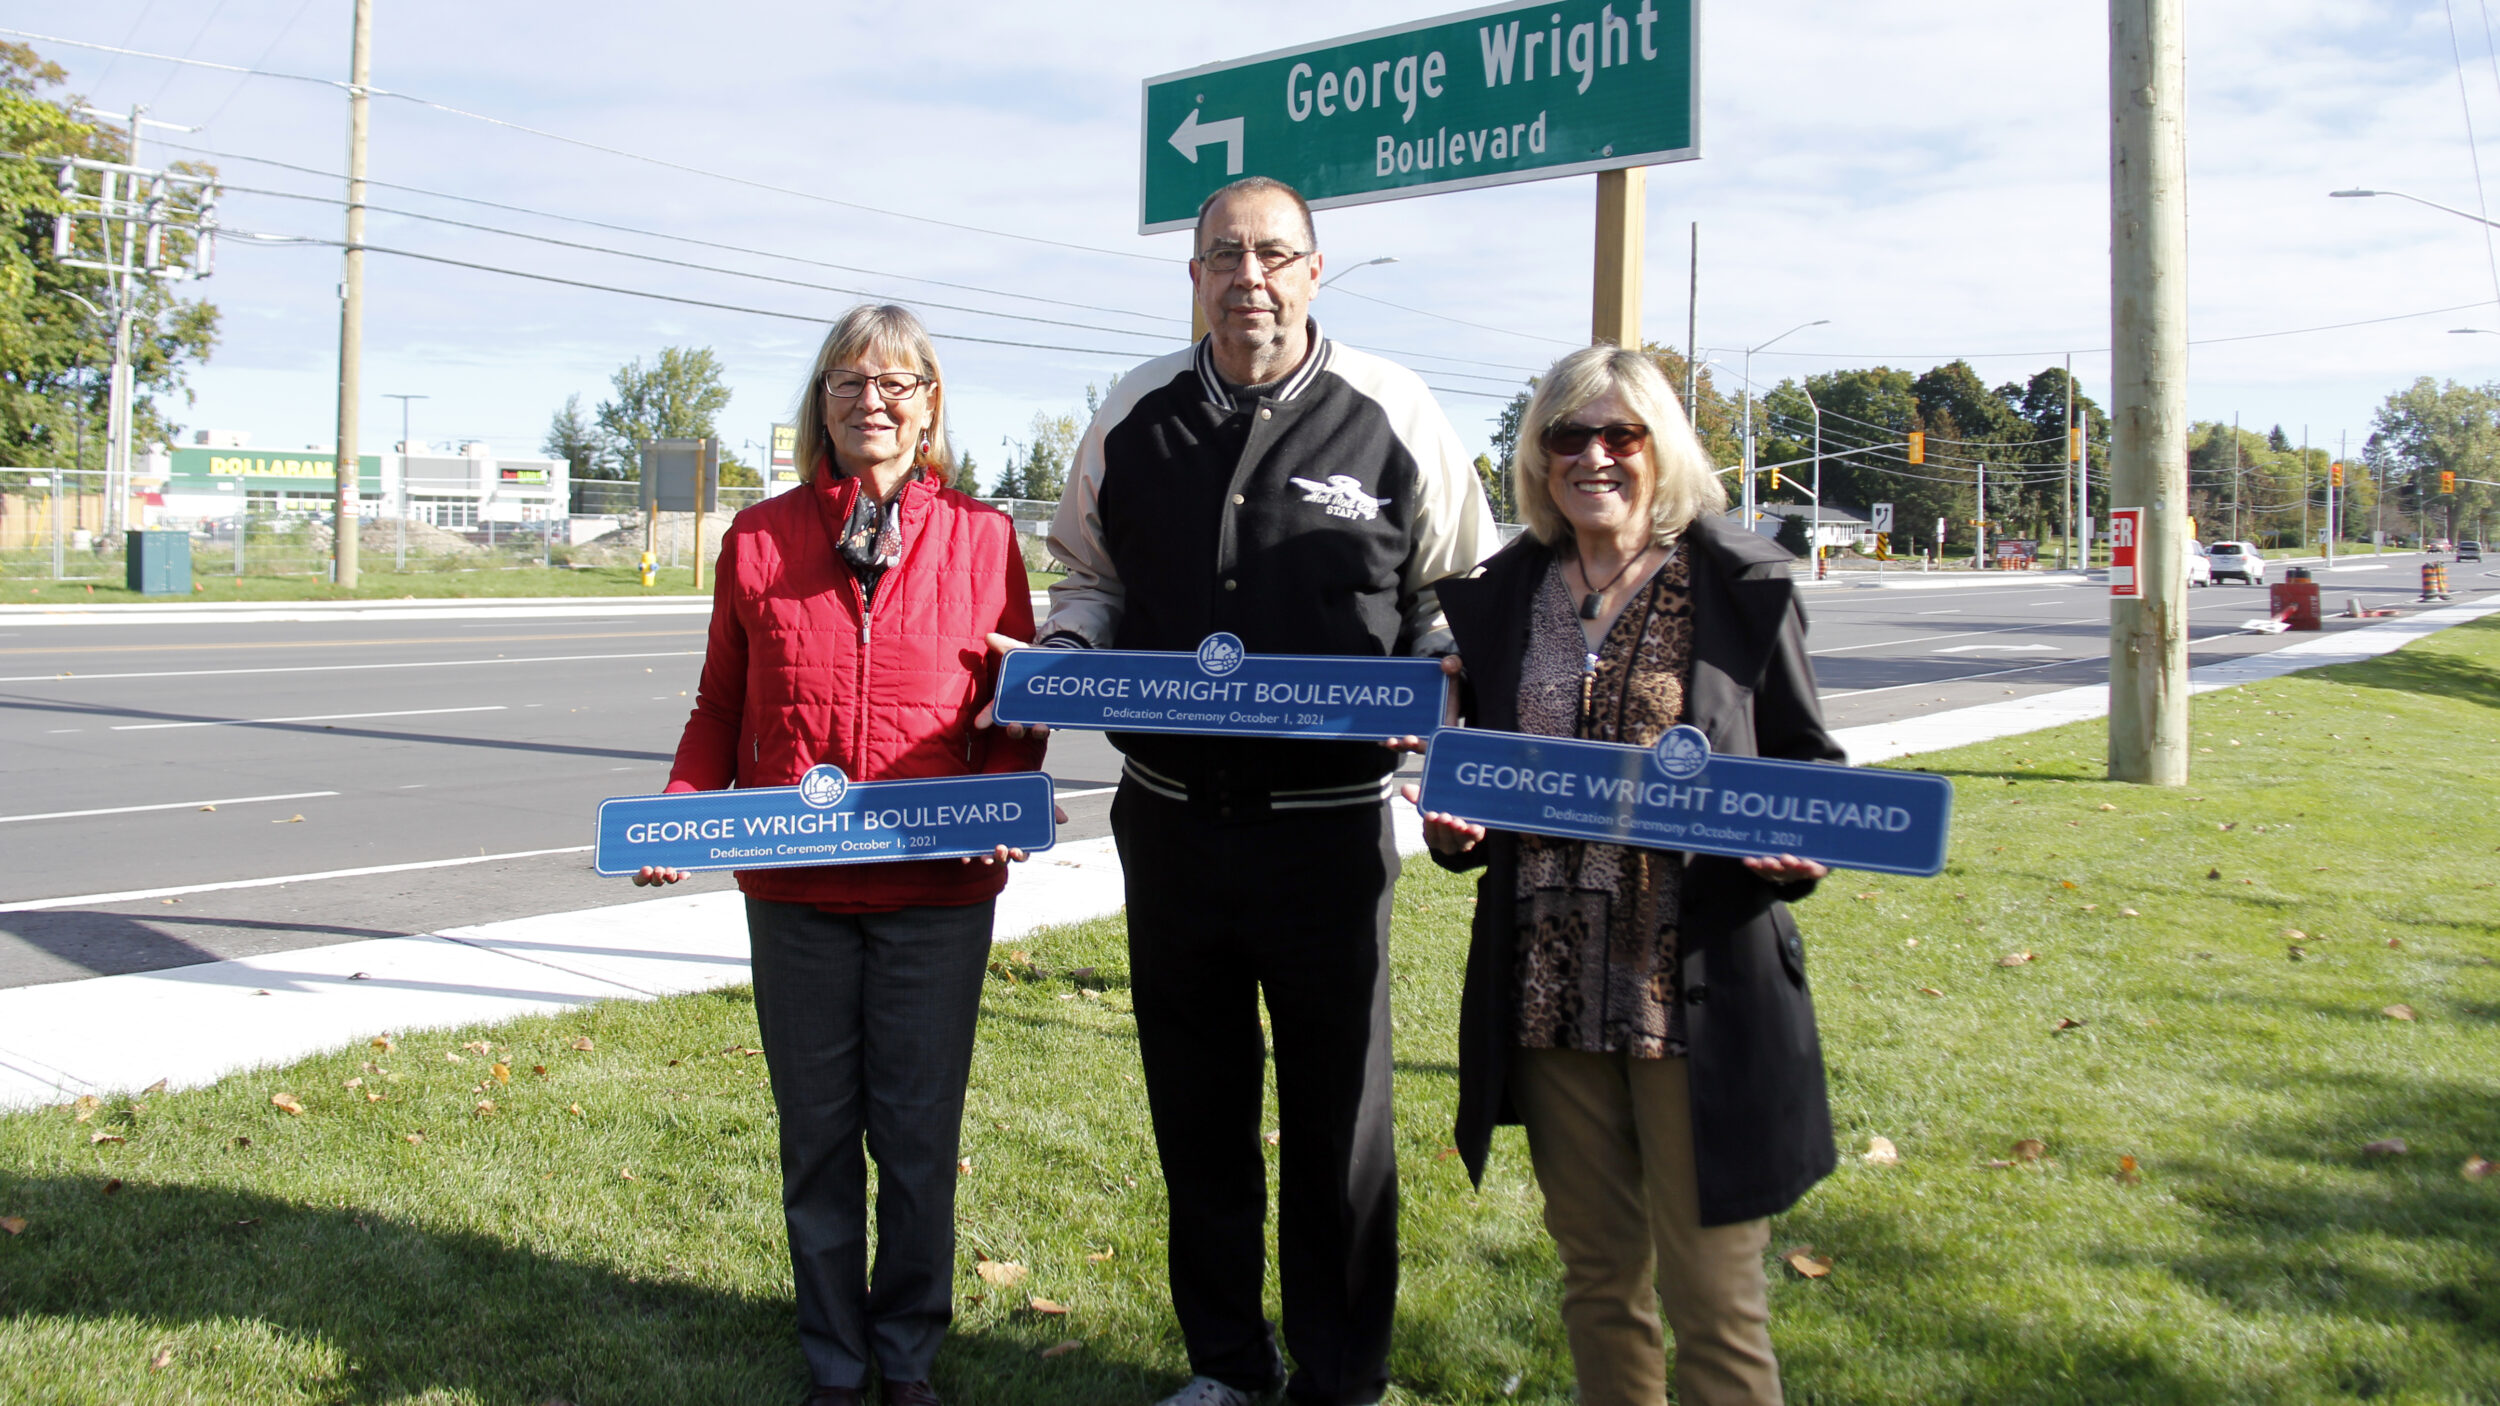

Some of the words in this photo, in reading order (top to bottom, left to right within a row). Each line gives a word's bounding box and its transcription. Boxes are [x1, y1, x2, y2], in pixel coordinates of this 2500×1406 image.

[1286, 50, 1447, 125] George
[1479, 0, 1659, 96] Wright
[1376, 110, 1547, 178] Boulevard
[210, 456, 337, 477] DOLLARAM
[1325, 505, 1361, 520] STAFF
[1027, 675, 1132, 698] GEORGE
[1139, 679, 1249, 702] WRIGHT
[1255, 683, 1415, 707] BOULEVARD
[1102, 706, 1163, 720] Dedication
[1166, 708, 1227, 724] Ceremony
[1229, 711, 1280, 724] October
[1284, 713, 1293, 726] 1,
[1296, 713, 1324, 726] 2021
[1455, 762, 1576, 796] GEORGE
[1585, 775, 1714, 812] WRIGHT
[1721, 790, 1911, 833] BOULEVARD
[626, 818, 735, 844] GEORGE
[743, 811, 855, 836] WRIGHT
[864, 802, 1022, 831] BOULEVARD
[1543, 805, 1614, 825] Dedication
[1618, 814, 1688, 837] Ceremony
[1691, 823, 1751, 841] October
[1769, 831, 1804, 847] 2021
[710, 846, 772, 859] Dedication
[777, 843, 838, 857] Ceremony
[841, 839, 892, 851] October
[897, 838, 906, 849] 1,
[909, 836, 937, 847] 2021
